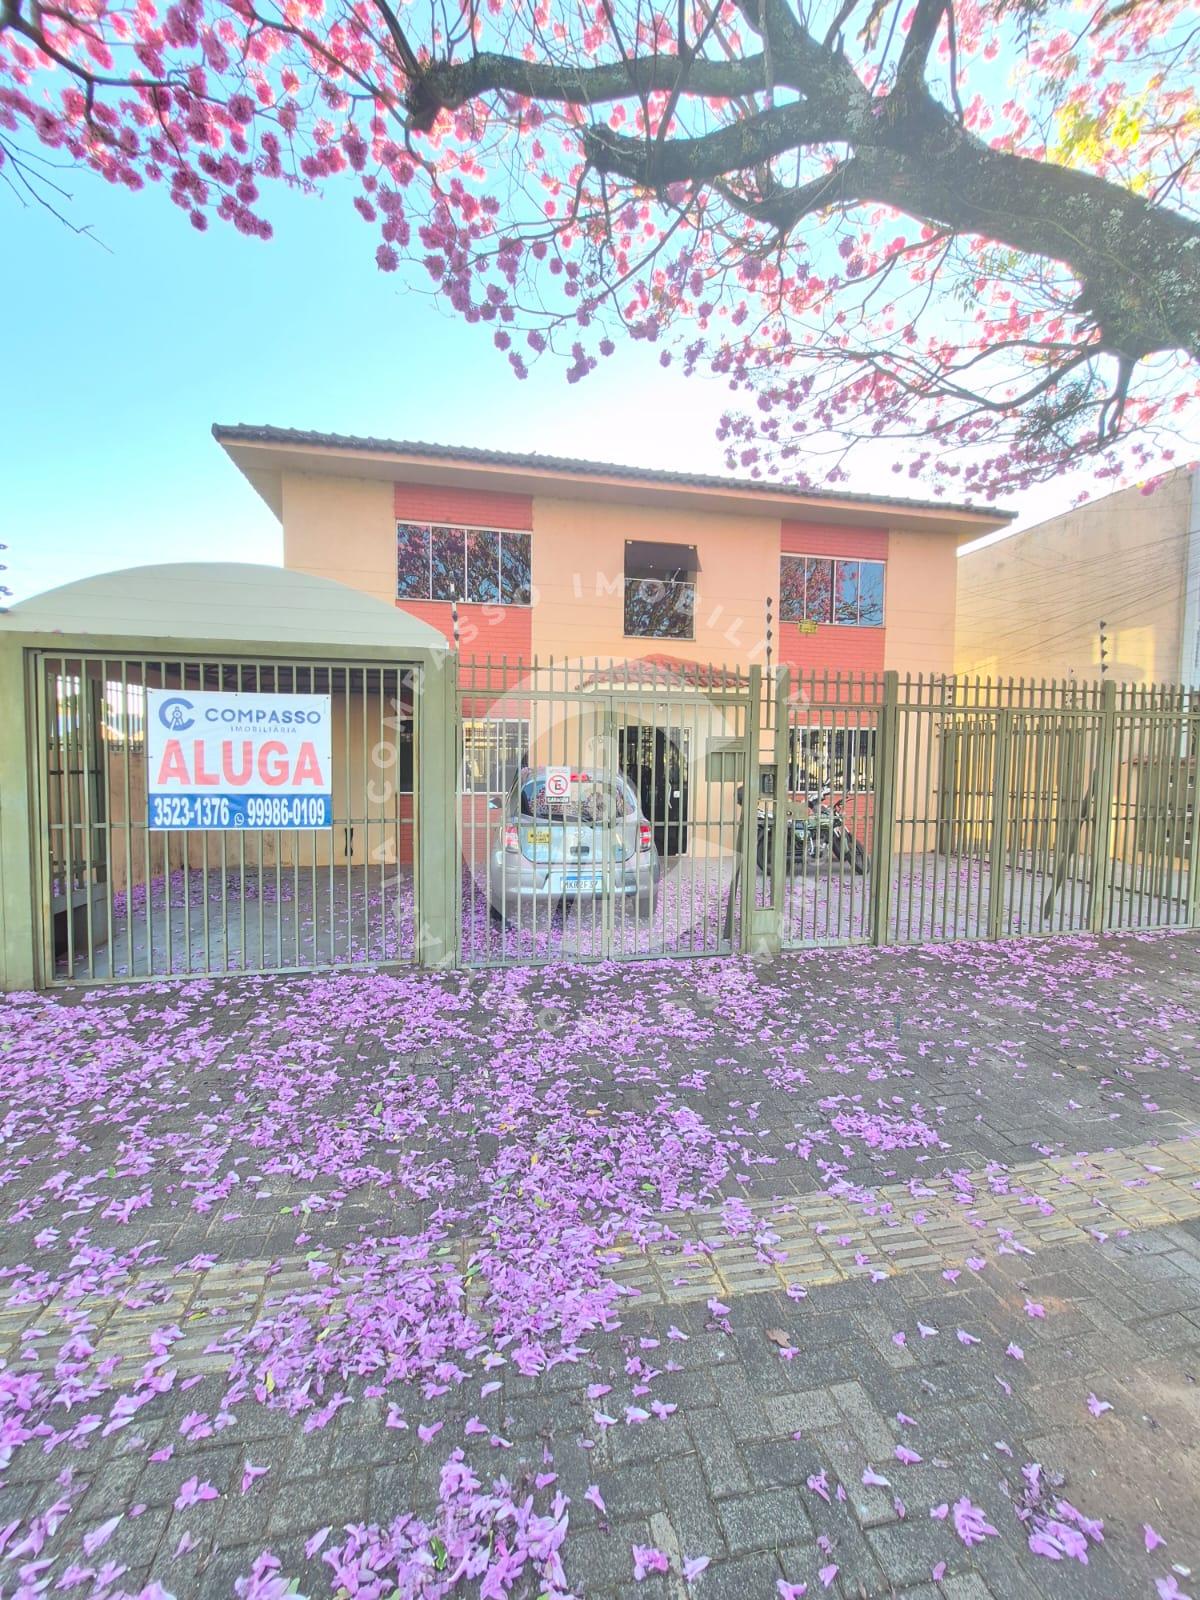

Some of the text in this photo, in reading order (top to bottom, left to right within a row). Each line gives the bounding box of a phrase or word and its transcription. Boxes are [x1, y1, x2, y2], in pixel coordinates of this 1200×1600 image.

[205, 707, 321, 724] COMPASSO
[157, 739, 325, 786] ALUGA
[154, 797, 325, 826] 3523-1376 99986-0109
